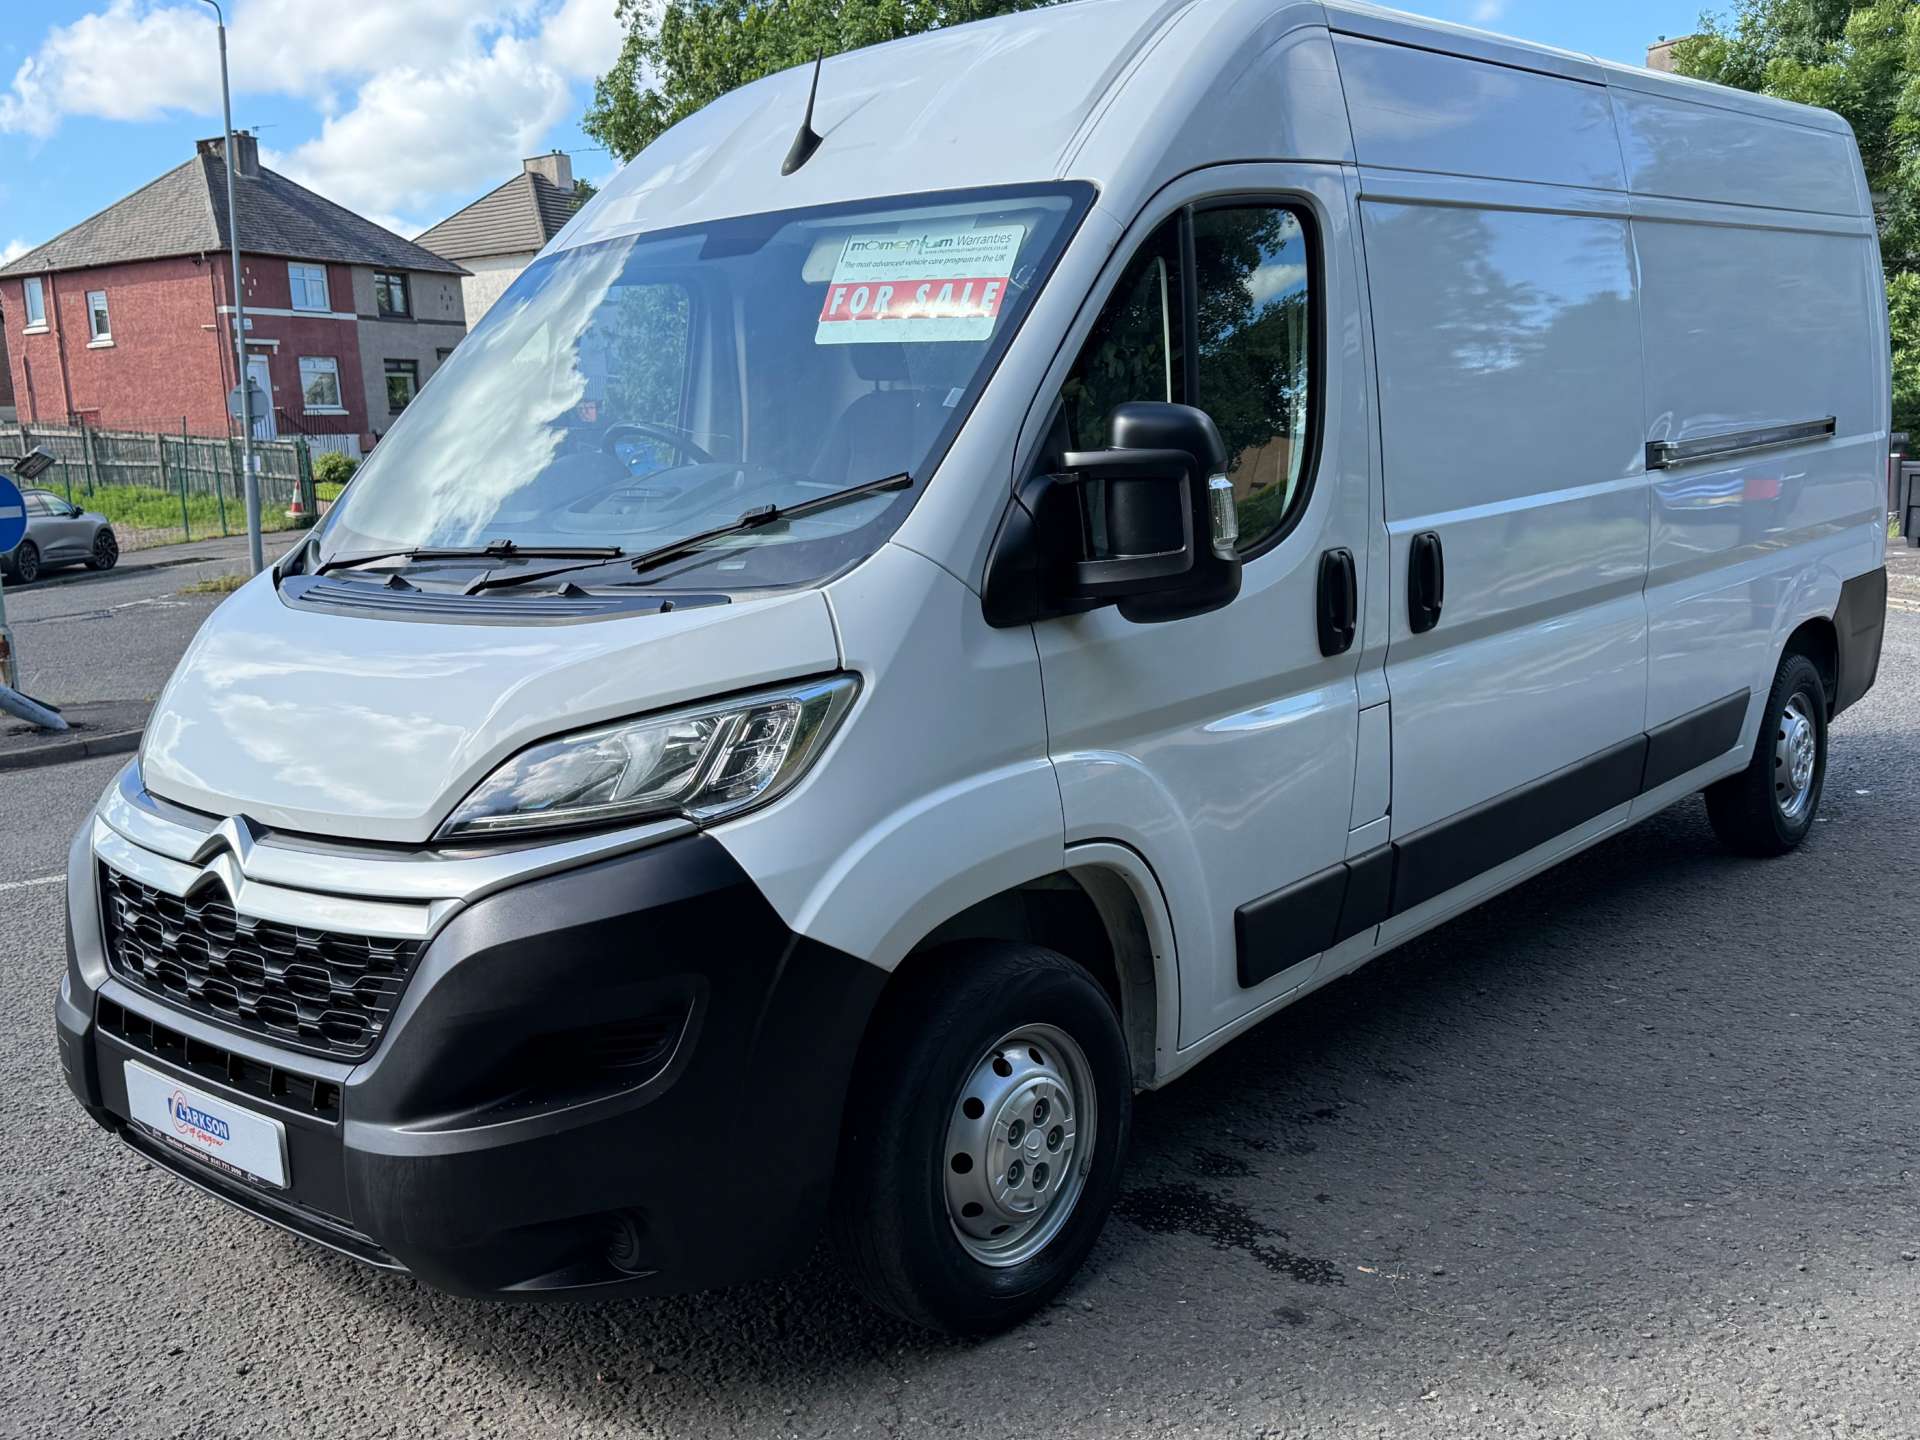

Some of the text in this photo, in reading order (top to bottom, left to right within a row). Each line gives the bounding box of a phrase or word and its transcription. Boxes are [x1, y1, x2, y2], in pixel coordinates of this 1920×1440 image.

[850, 232, 1013, 255] momentum Warranties
[856, 260, 871, 268] most
[872, 259, 905, 267] advanced
[905, 258, 927, 266] vehicle
[928, 257, 944, 265] care
[944, 256, 974, 265] program
[982, 254, 993, 262] the
[828, 281, 1001, 316] FOR SALE
[171, 1088, 228, 1139] CLARKSON
